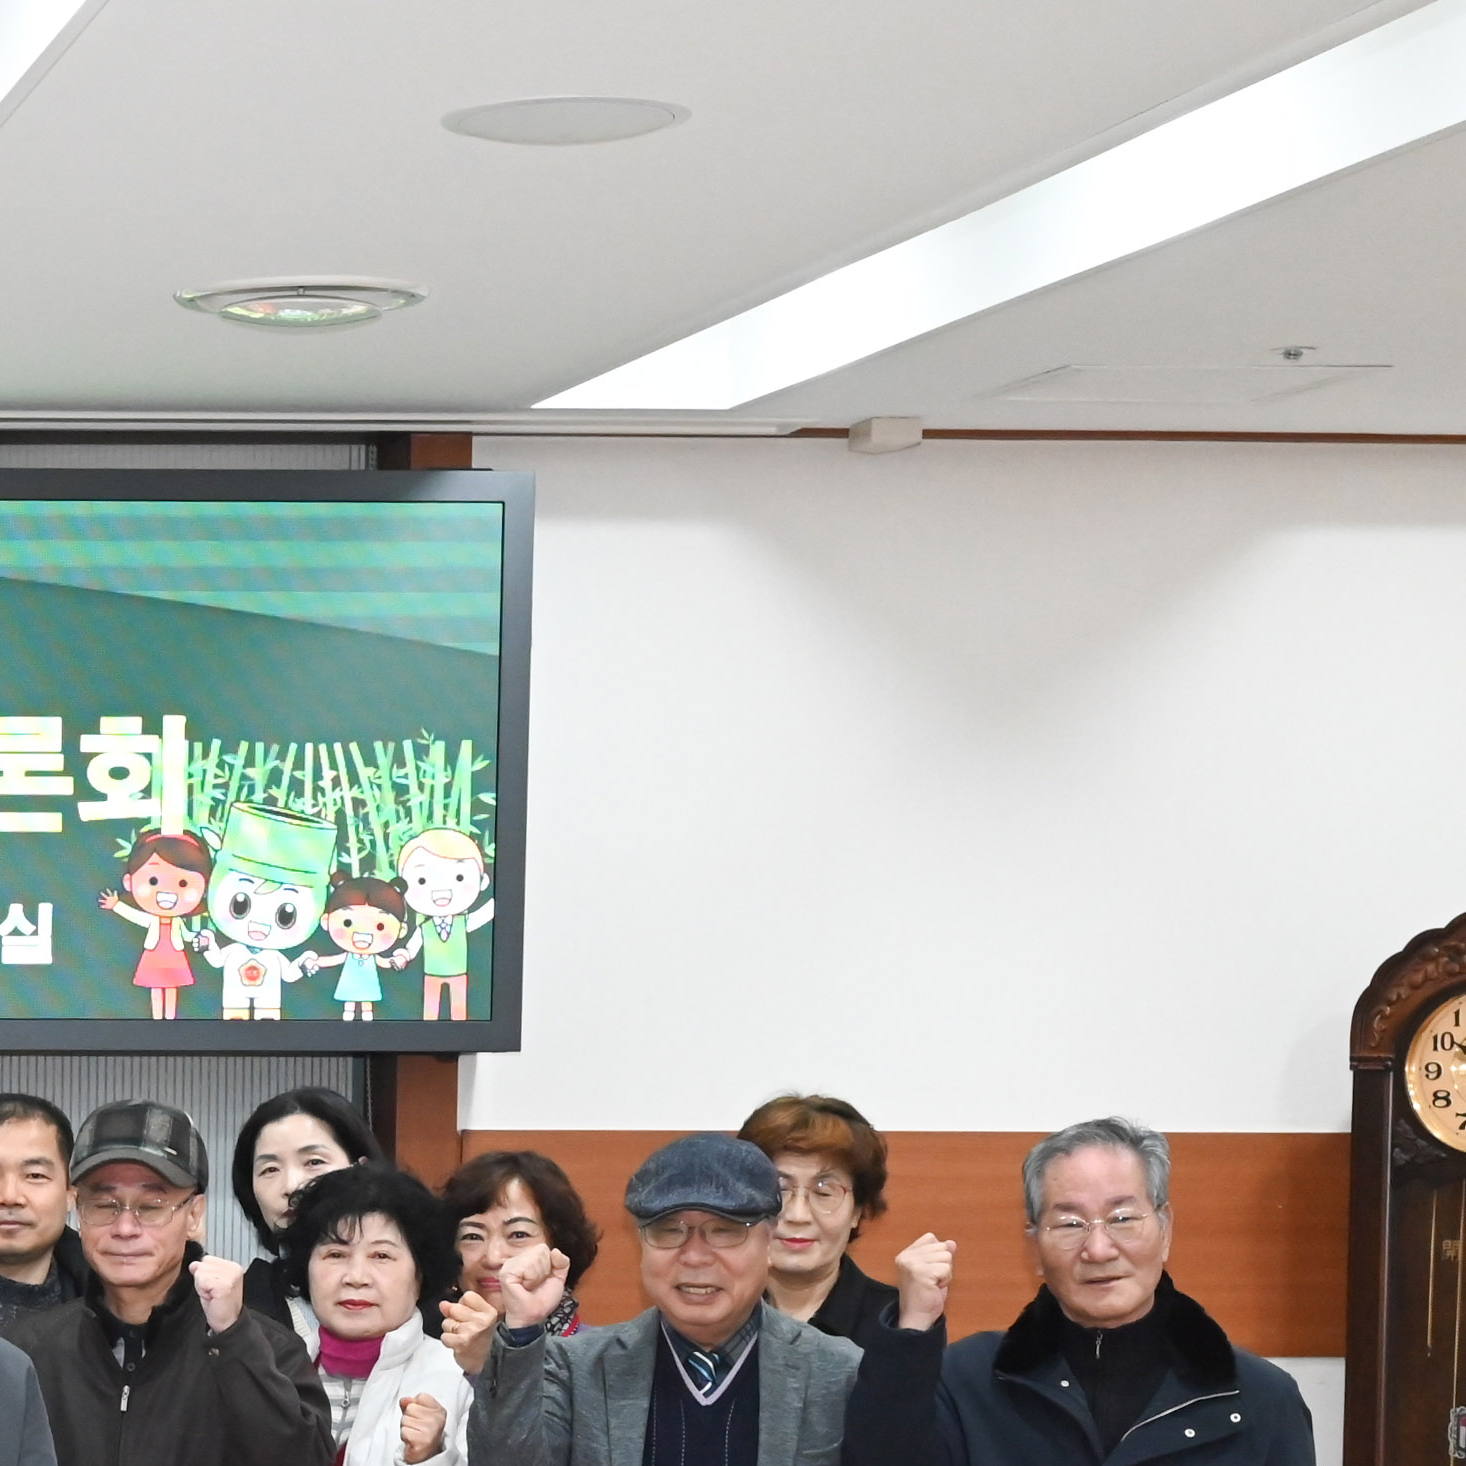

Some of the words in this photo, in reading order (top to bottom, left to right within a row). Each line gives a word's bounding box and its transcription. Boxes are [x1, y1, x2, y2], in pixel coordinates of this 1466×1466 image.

[1432, 1031, 1454, 1052] 10
[1424, 1061, 1442, 1080] 9
[1432, 1089, 1452, 1108] 8
